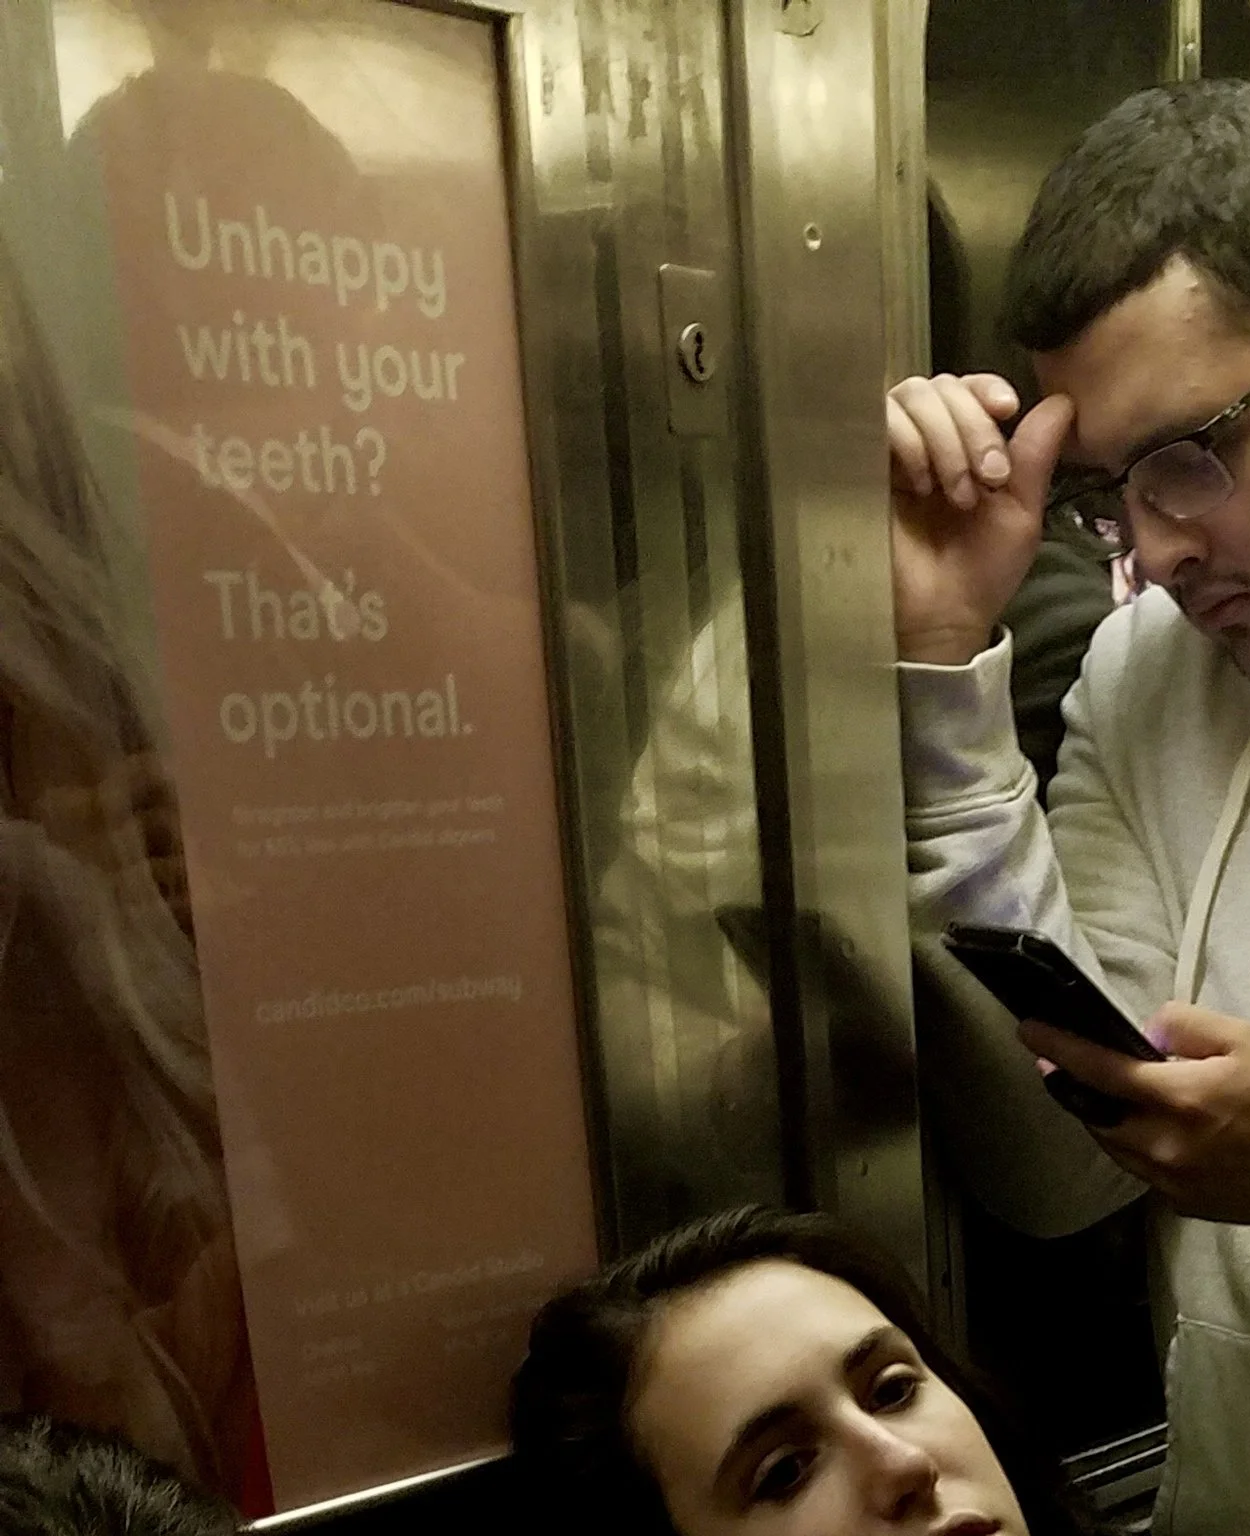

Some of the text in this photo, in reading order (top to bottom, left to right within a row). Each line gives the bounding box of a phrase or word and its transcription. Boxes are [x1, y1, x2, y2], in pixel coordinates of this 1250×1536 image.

[165, 191, 448, 318] Unhappy
[176, 310, 466, 412] with your
[191, 423, 388, 497] teeth?
[203, 565, 390, 643] That's
[219, 673, 476, 759] optional.
